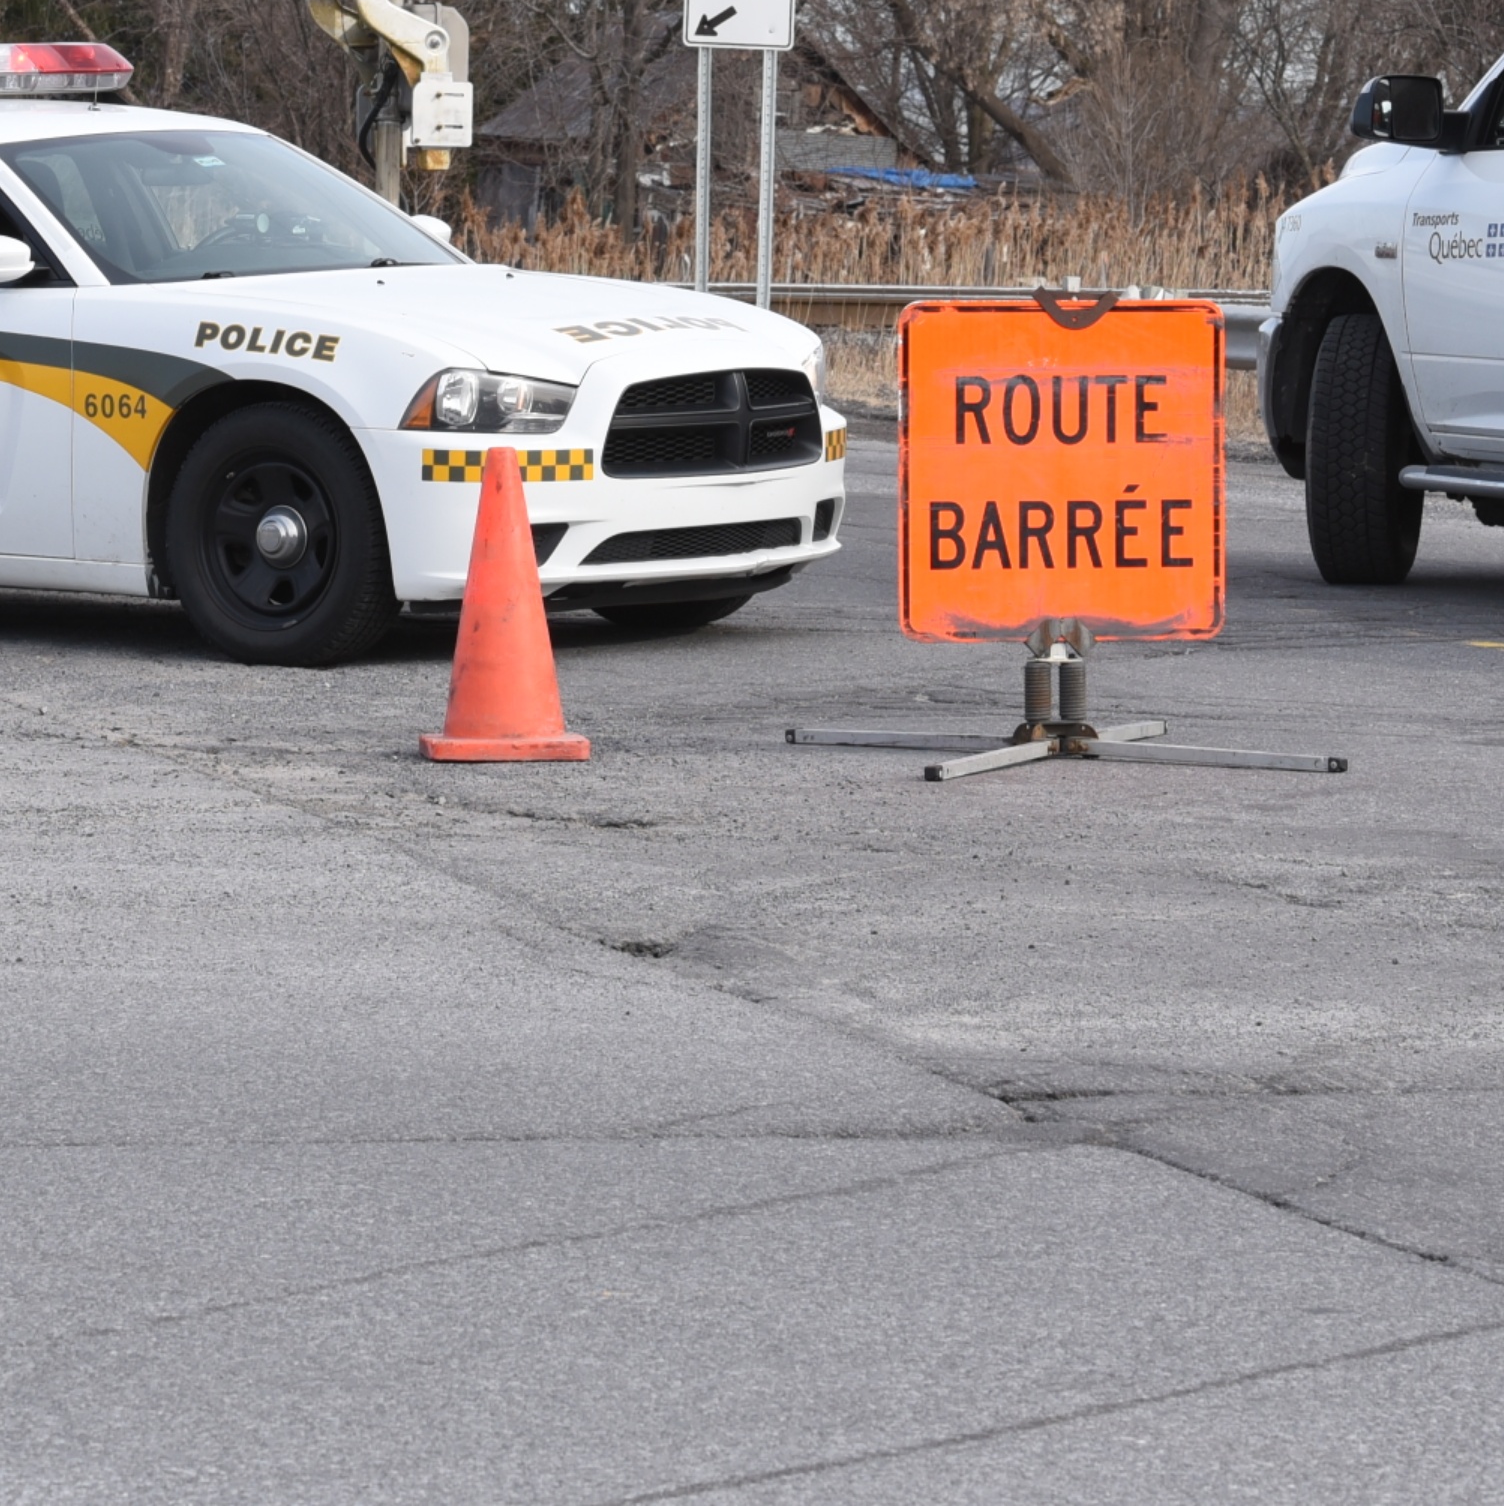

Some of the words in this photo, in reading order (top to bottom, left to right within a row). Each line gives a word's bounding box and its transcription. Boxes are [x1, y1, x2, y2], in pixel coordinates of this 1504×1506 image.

[1412, 211, 1459, 229] Transports
[1429, 230, 1484, 265] Québec
[194, 321, 341, 362] POLICE
[84, 393, 147, 419] 6064
[955, 374, 1168, 446] ROUTE
[929, 484, 1194, 571] BARRÉE
